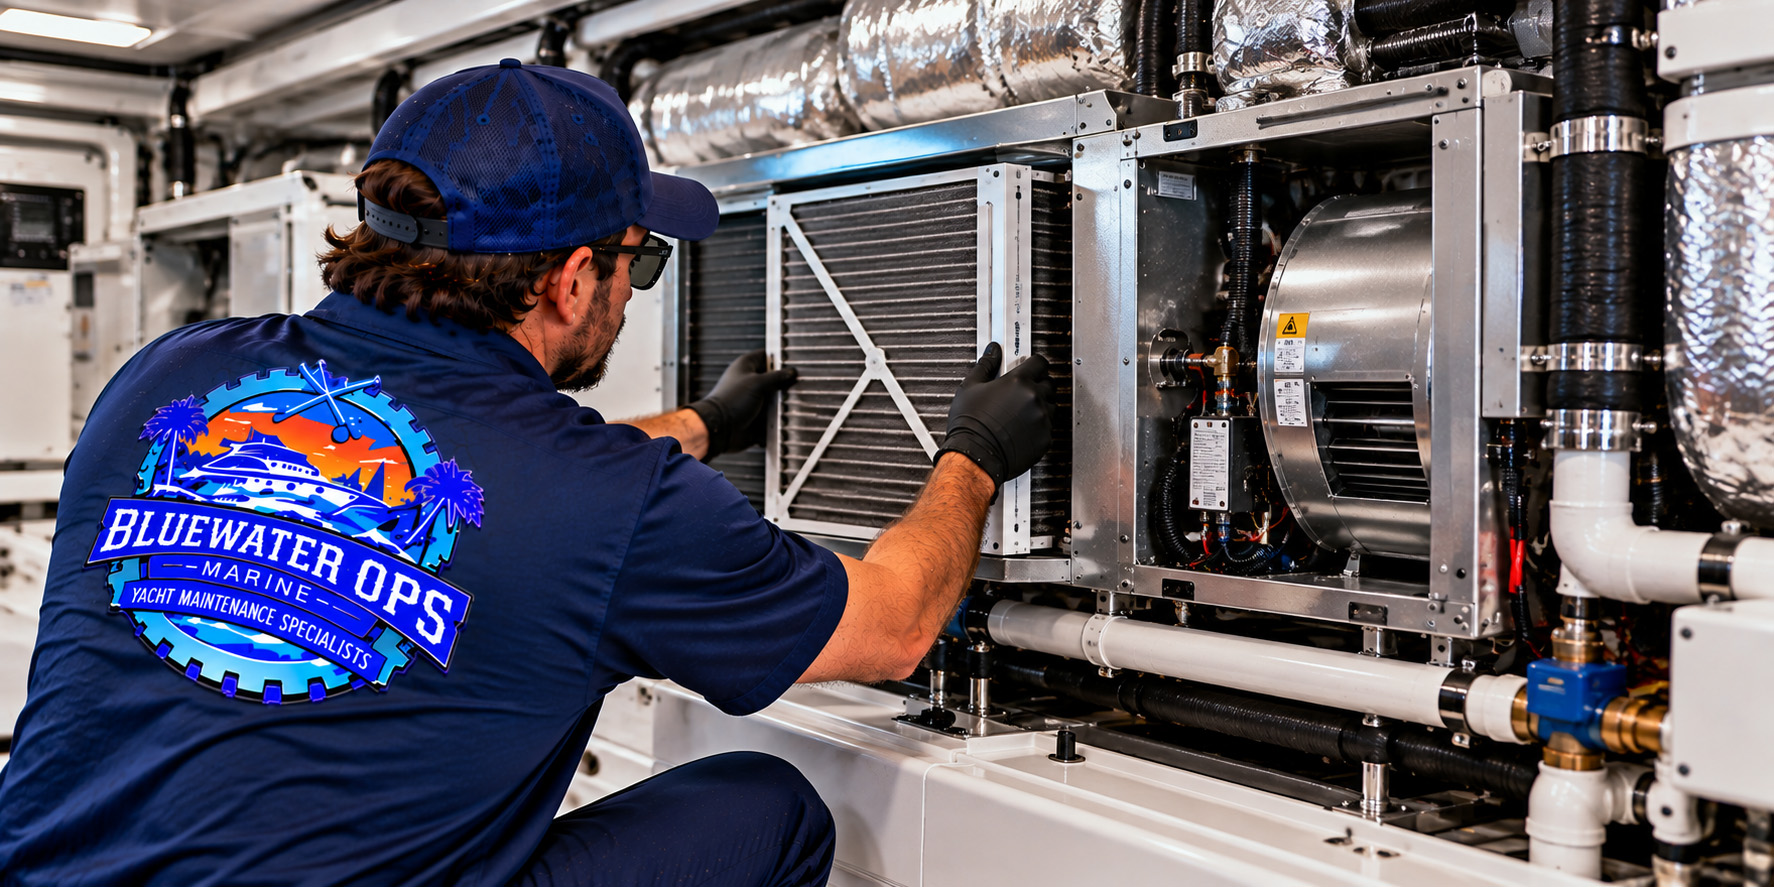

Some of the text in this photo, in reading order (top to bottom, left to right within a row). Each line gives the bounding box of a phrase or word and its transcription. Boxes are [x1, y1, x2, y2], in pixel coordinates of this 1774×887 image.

[100, 508, 453, 646] BLUEWATER OPS
[202, 560, 312, 604] MARINE
[131, 587, 373, 671] YACHT MAINTENANCE SPECIALISTS
